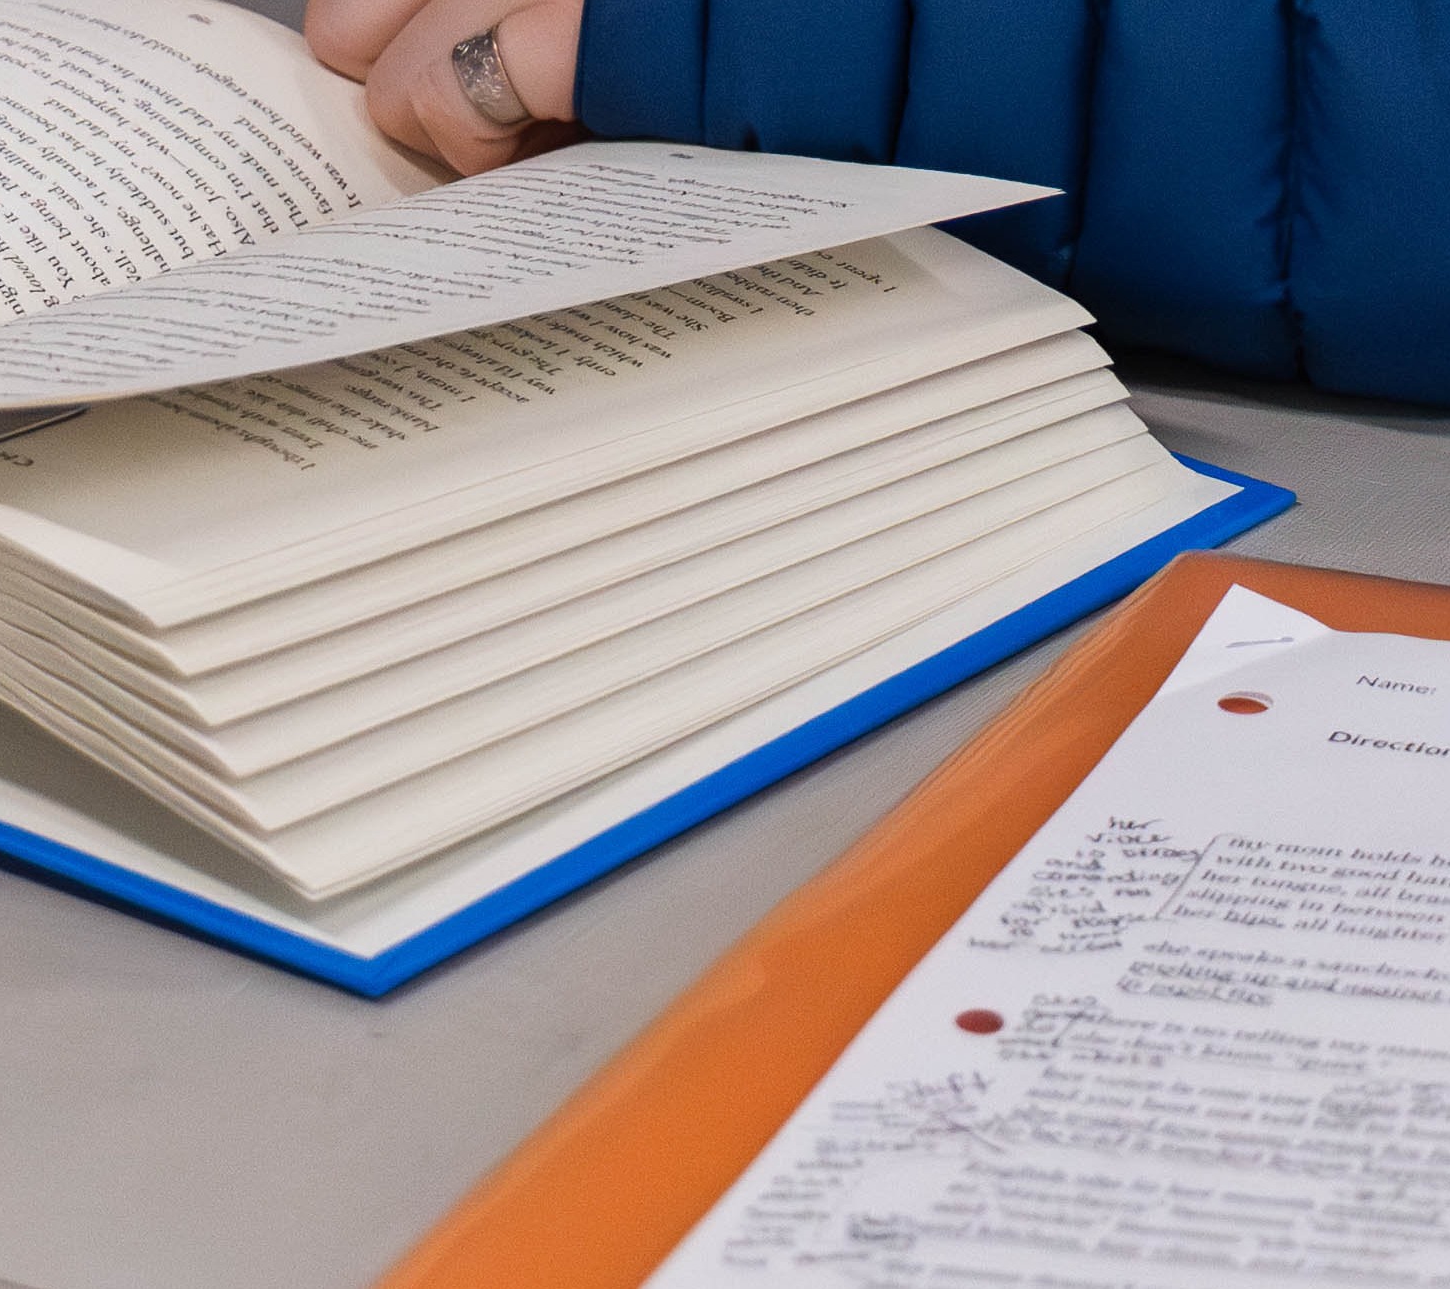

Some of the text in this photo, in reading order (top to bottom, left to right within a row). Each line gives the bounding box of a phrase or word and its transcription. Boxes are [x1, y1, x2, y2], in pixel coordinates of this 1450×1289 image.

[178, 107, 239, 149] my dad
[38, 146, 97, 188] actually
[108, 140, 202, 223] he my
[30, 198, 71, 240] being
[83, 215, 109, 238] she
[106, 167, 194, 260] but suddenly
[19, 226, 47, 253] like
[3, 255, 46, 293] loved
[47, 255, 74, 289] You
[70, 240, 111, 286] about
[1357, 674, 1437, 695] Name:
